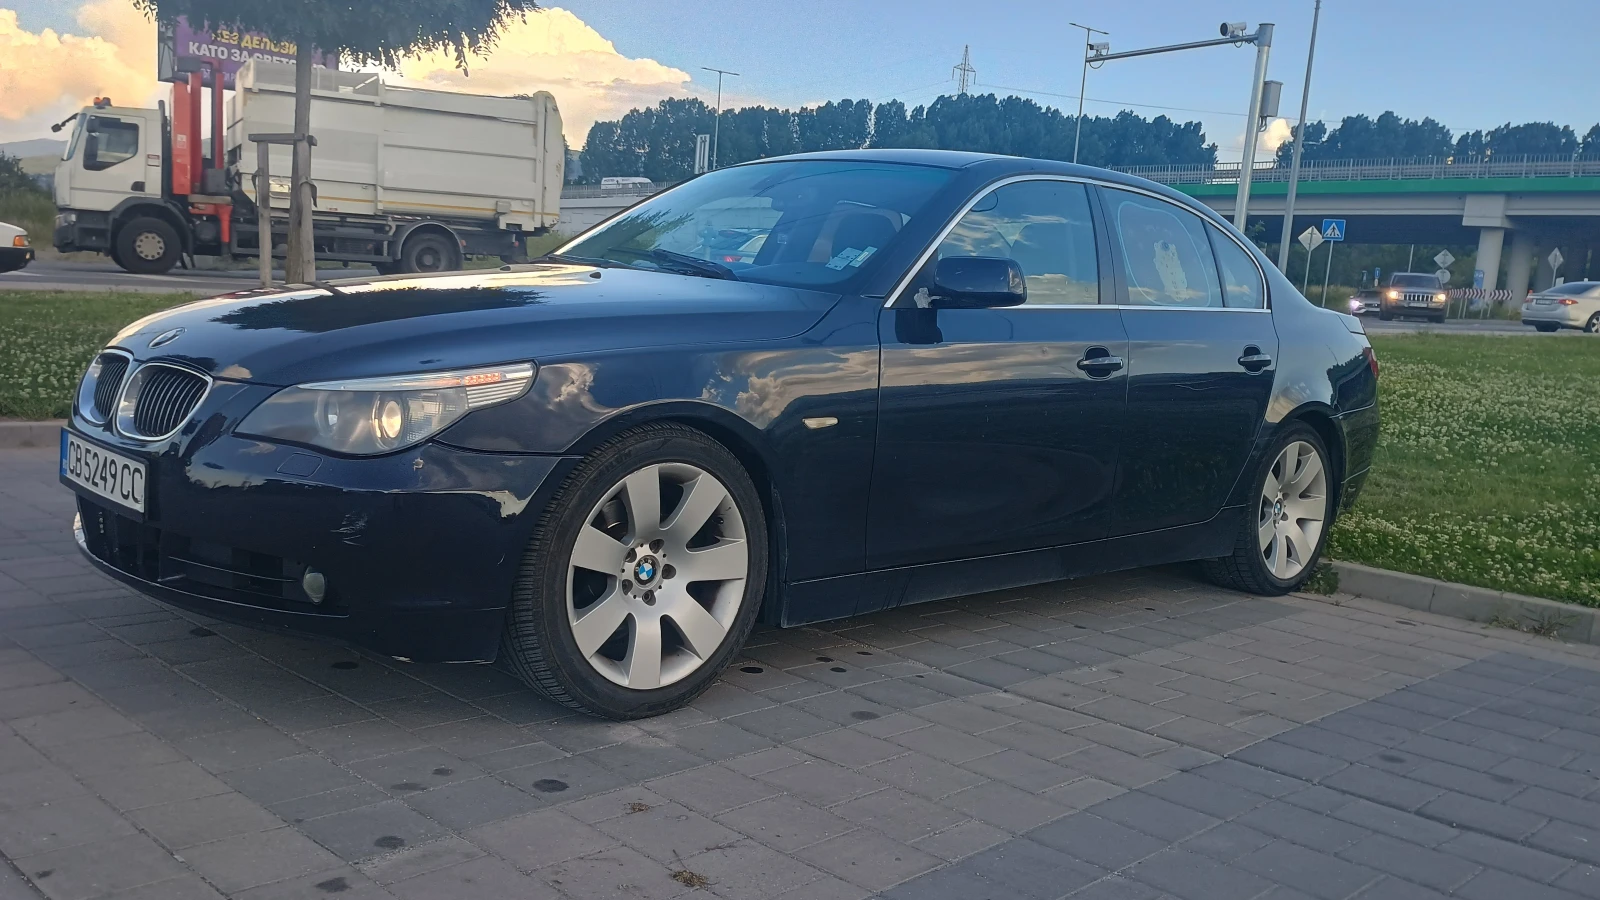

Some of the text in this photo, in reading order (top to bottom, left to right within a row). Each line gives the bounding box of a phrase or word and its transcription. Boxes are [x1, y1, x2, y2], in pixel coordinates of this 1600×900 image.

[189, 41, 228, 60] КАТО
[231, 48, 251, 63] ЗА
[69, 440, 143, 504] CB 5249 CC
